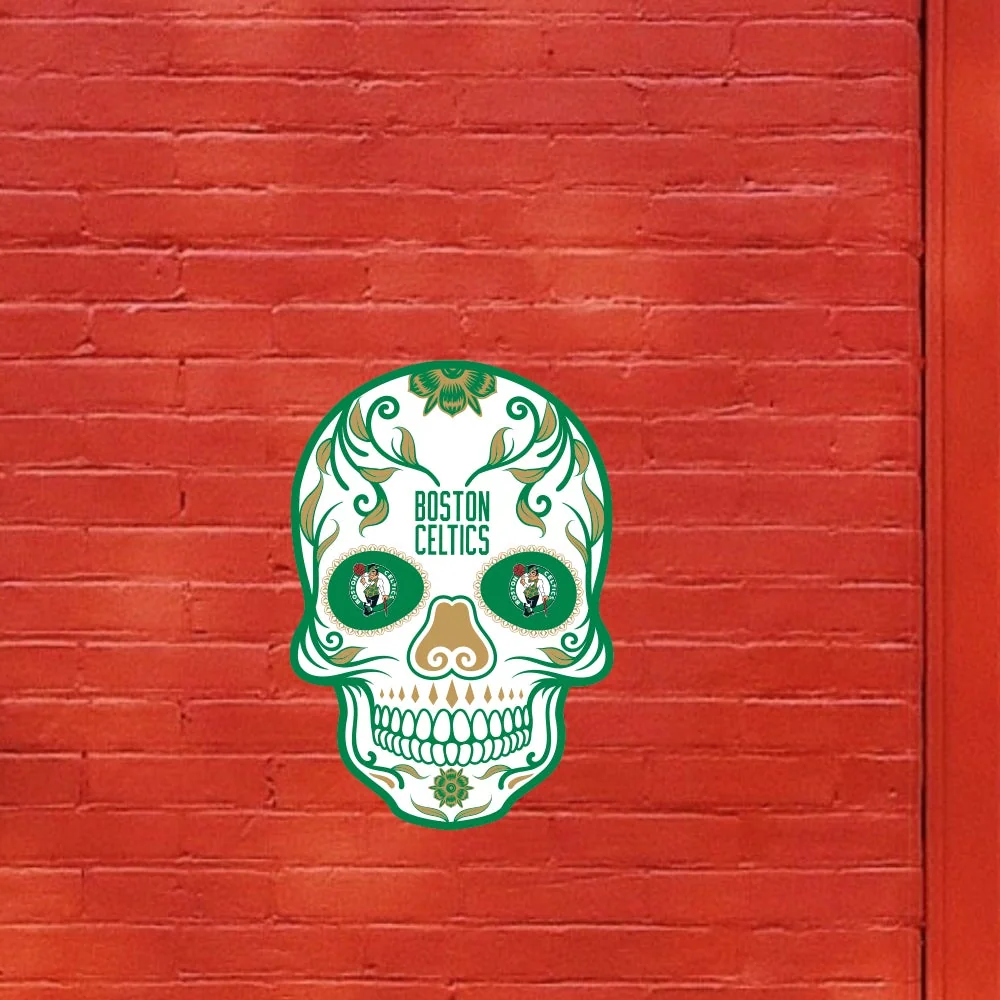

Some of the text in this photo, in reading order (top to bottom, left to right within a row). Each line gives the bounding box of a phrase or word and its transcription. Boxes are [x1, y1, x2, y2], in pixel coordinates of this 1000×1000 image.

[415, 490, 490, 522] BOSTON
[415, 524, 490, 556] CELTICS
[350, 570, 397, 605] BOSTON CELTICS
[510, 571, 557, 606] BOSTON CELTICS
